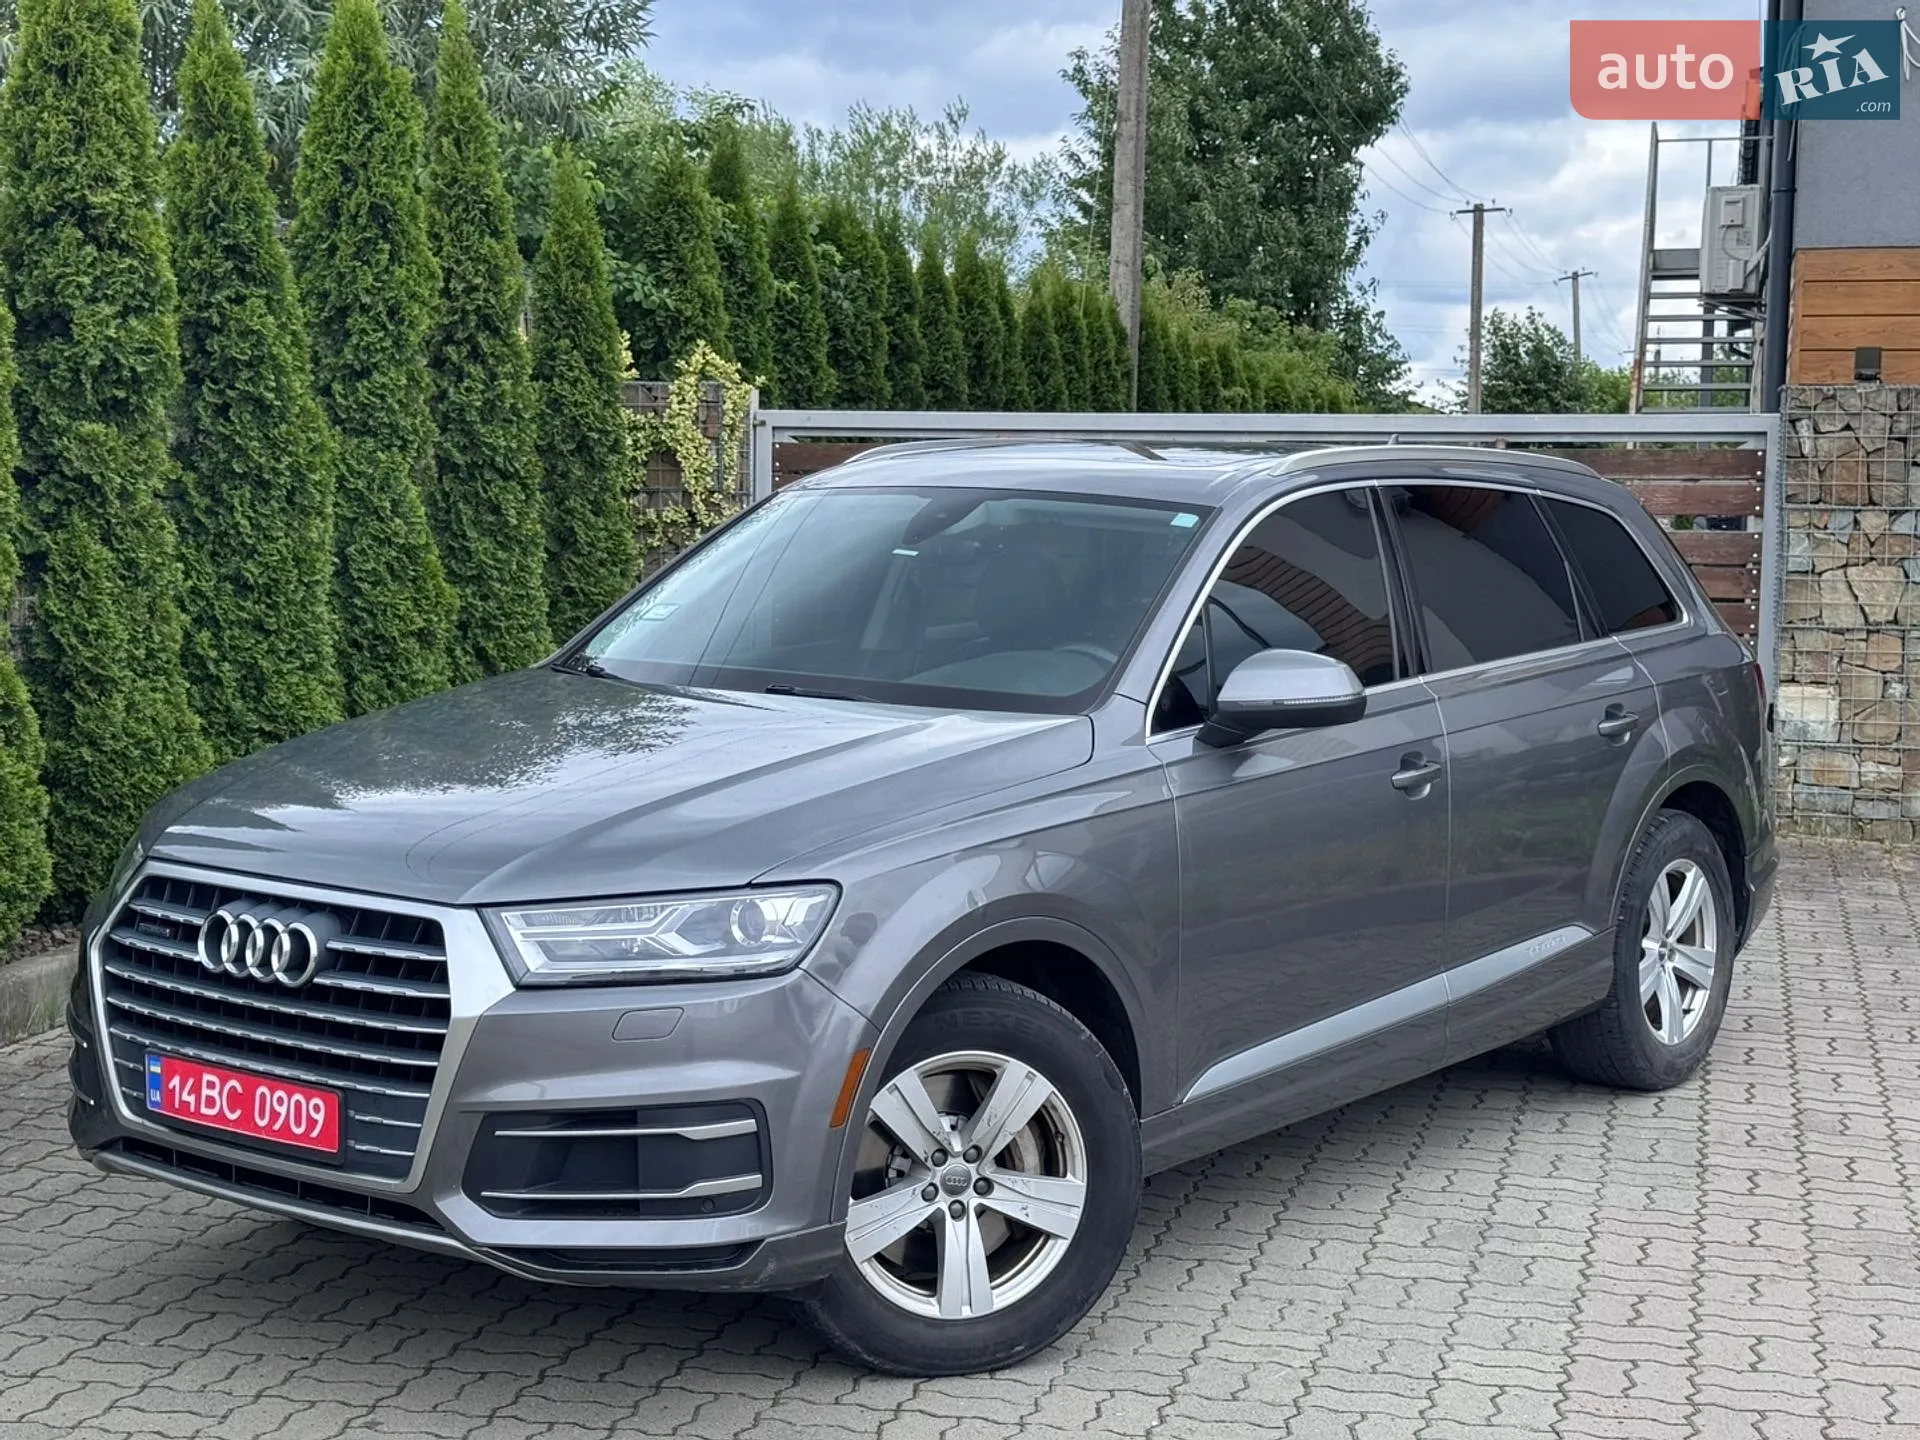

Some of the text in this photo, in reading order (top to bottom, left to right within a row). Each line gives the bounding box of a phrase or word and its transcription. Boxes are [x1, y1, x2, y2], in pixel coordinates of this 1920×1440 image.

[150, 1089, 161, 1102] UA
[168, 1072, 326, 1138] 14BC 0909
